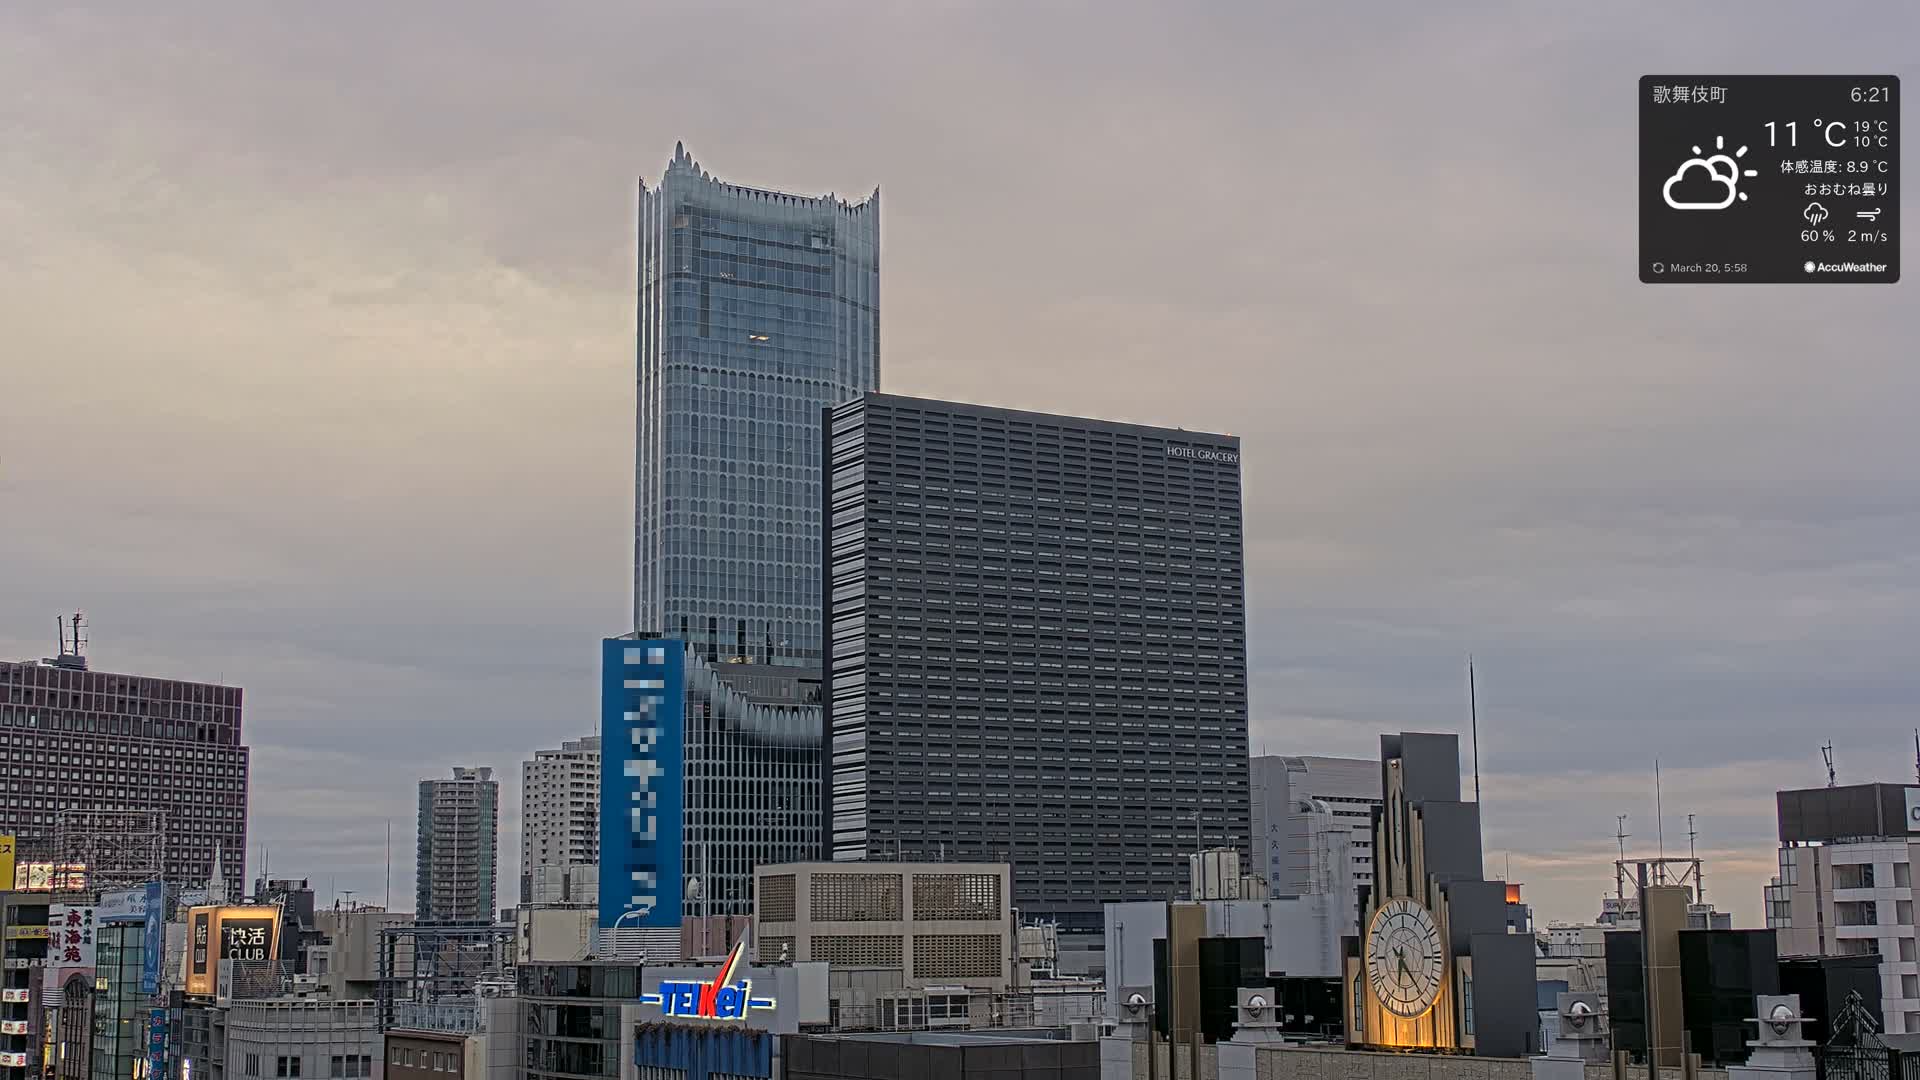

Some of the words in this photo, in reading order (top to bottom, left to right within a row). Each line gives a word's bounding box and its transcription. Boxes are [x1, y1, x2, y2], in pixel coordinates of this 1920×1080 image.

[1167, 446, 1196, 458] HOTEL
[1197, 450, 1239, 463] GRACERY
[63, 908, 83, 962] 東海苑
[230, 927, 266, 945] 快活
[229, 948, 264, 960] CLUB
